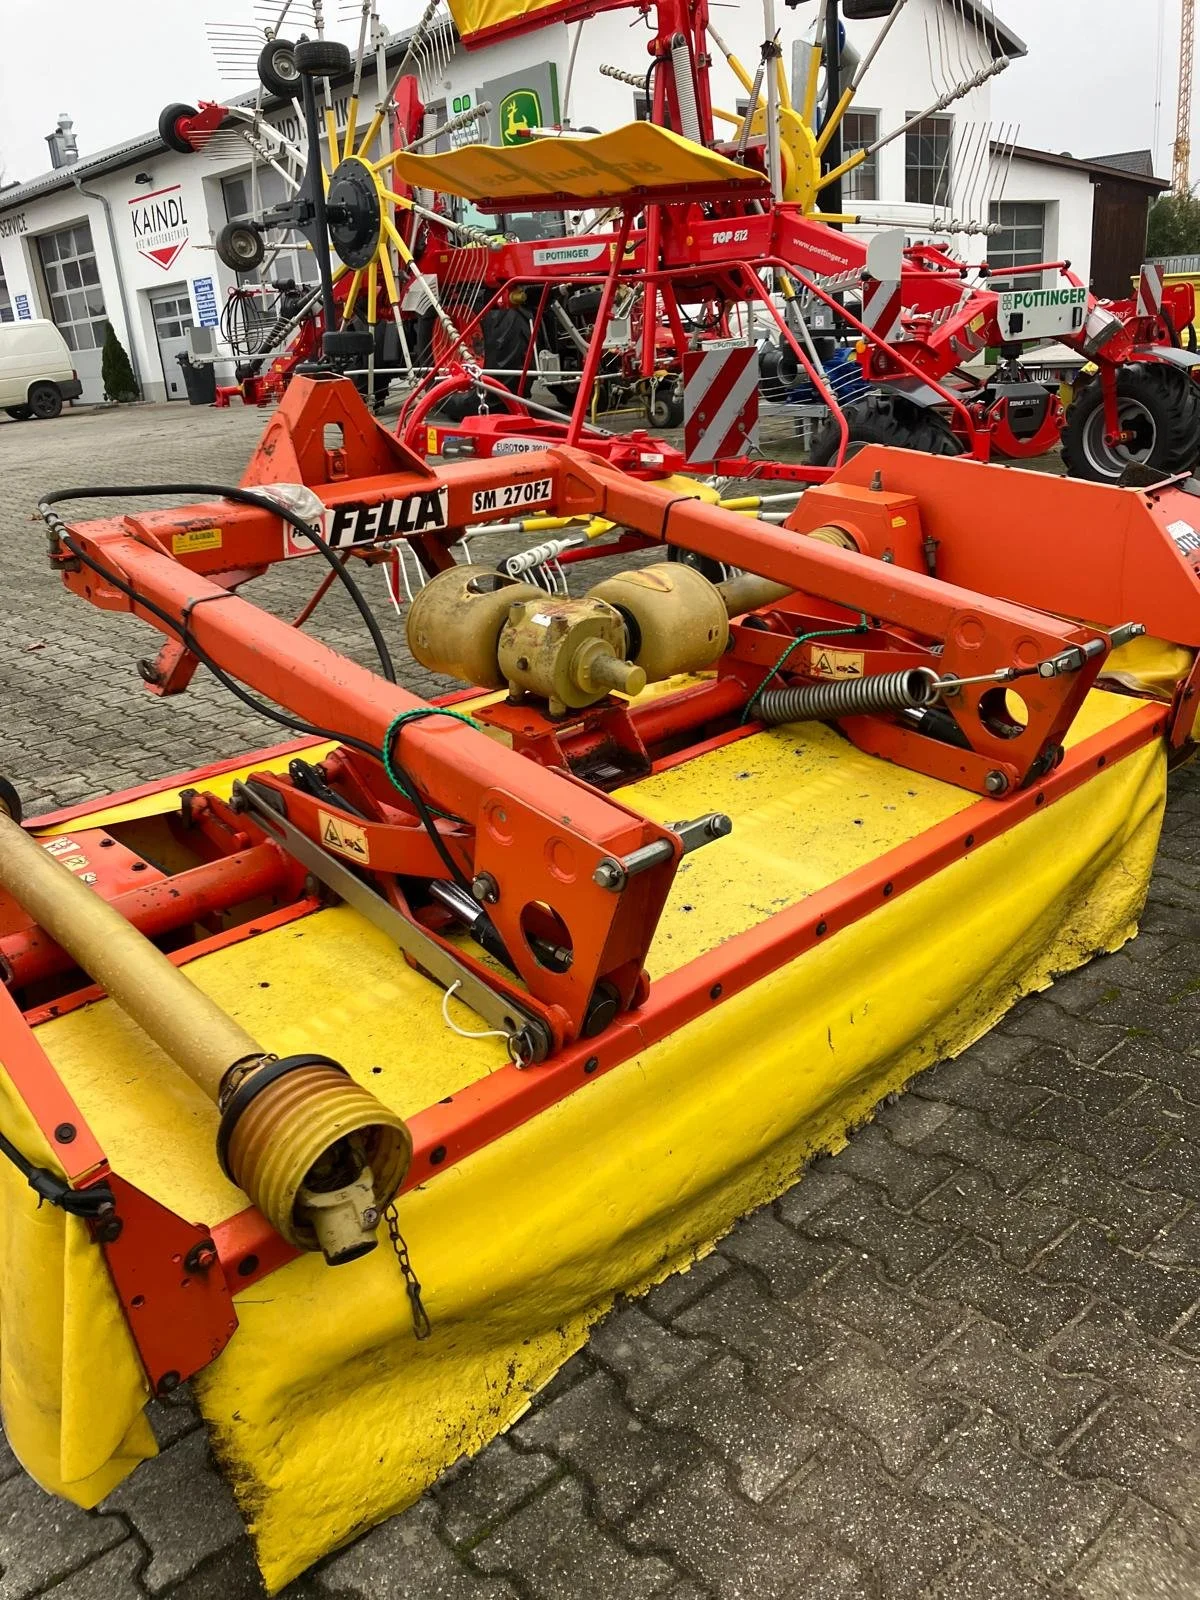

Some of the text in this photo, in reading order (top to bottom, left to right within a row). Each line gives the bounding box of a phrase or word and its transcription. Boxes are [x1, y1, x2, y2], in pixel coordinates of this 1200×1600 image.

[0, 213, 28, 238] SERVICE
[131, 196, 188, 238] KAINDL
[713, 232, 732, 245] TOP
[793, 238, 849, 265] www.poettinger.at
[496, 443, 530, 452] EUROTOP
[474, 480, 551, 511] SM 270FZ
[292, 491, 447, 547] FEA FELLA
